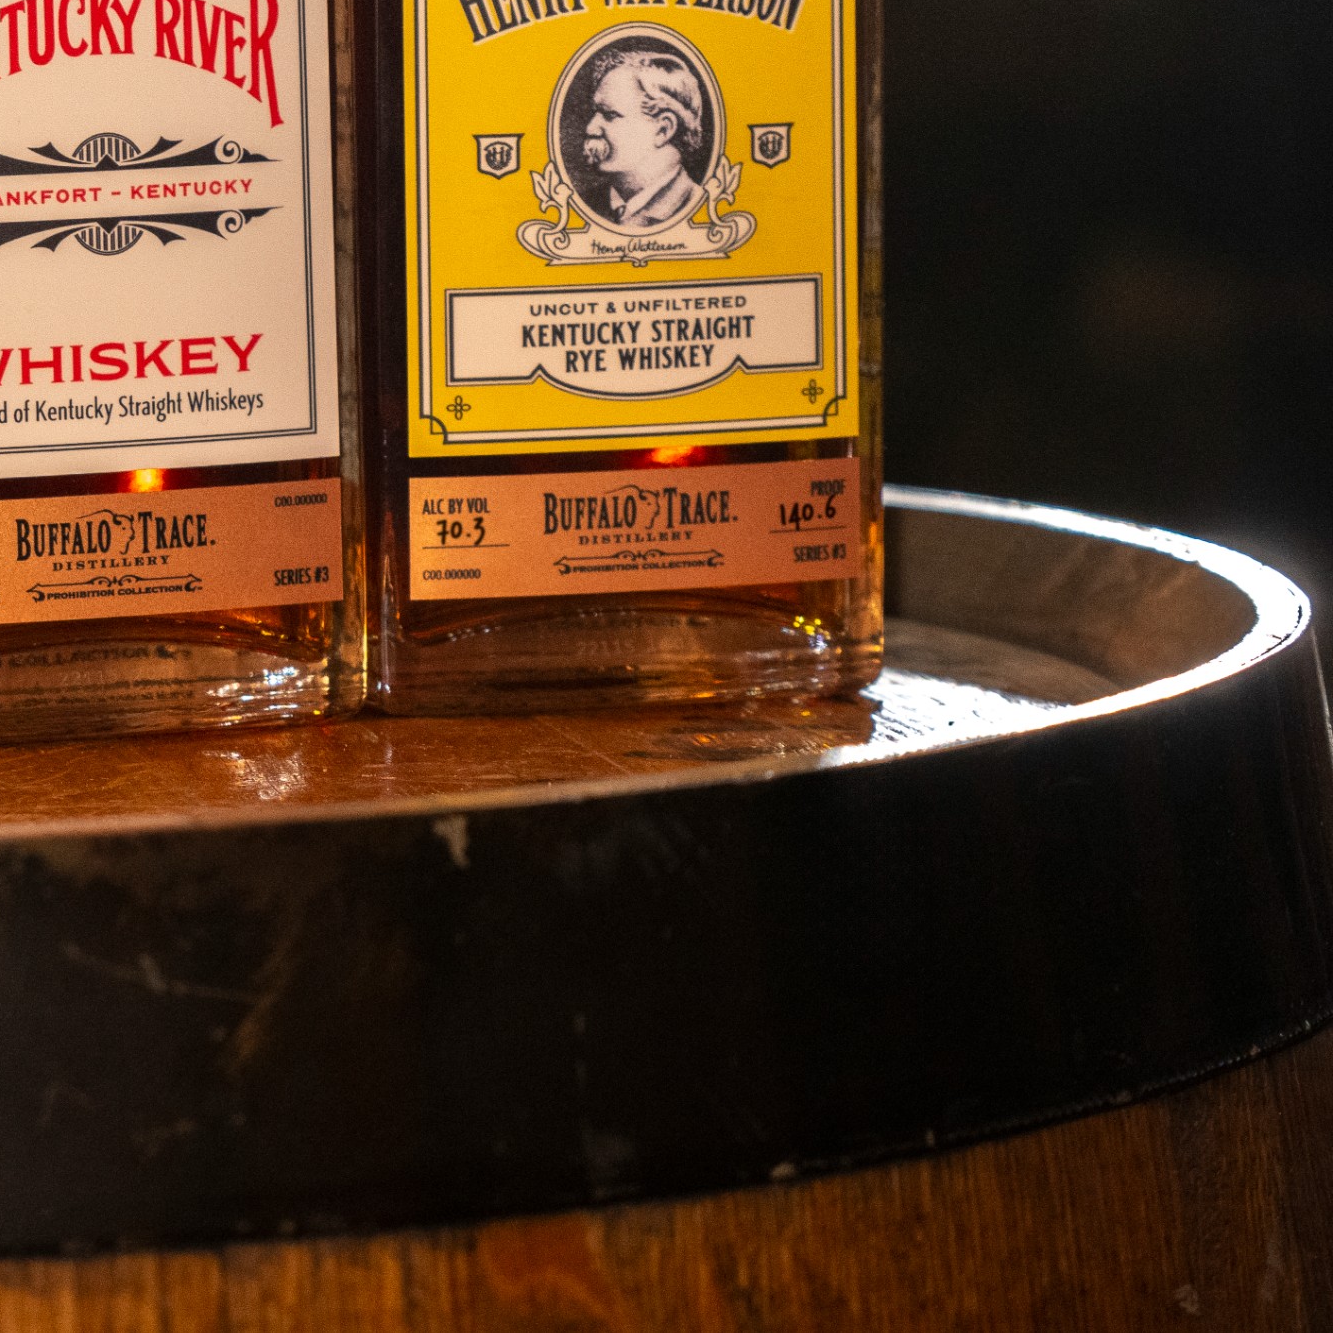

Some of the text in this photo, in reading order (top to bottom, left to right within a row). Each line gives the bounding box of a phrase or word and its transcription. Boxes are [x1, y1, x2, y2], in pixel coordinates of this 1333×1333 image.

[130, 179, 254, 200] KENTUCKY
[529, 295, 747, 317] UNCUT UNFILTERED
[522, 315, 755, 349] KENTUCKY STRAIGHT
[565, 343, 716, 374] RYE WHISKEY
[14, 399, 31, 424] of
[35, 395, 114, 425] Kentucky
[118, 391, 183, 422] Straight
[187, 389, 264, 417] Whiskeys
[811, 479, 846, 496] PROOF
[423, 498, 490, 514] ALC BY VOL
[544, 493, 637, 534] BUFFALO
[780, 495, 836, 532] 140.6
[16, 518, 111, 561] BUFFALO
[436, 517, 485, 546] 70.3
[578, 531, 692, 545] DISTILLERY
[52, 555, 170, 572] DISTILLERY
[794, 544, 829, 563] SERIES
[274, 566, 329, 586] SERIES #3
